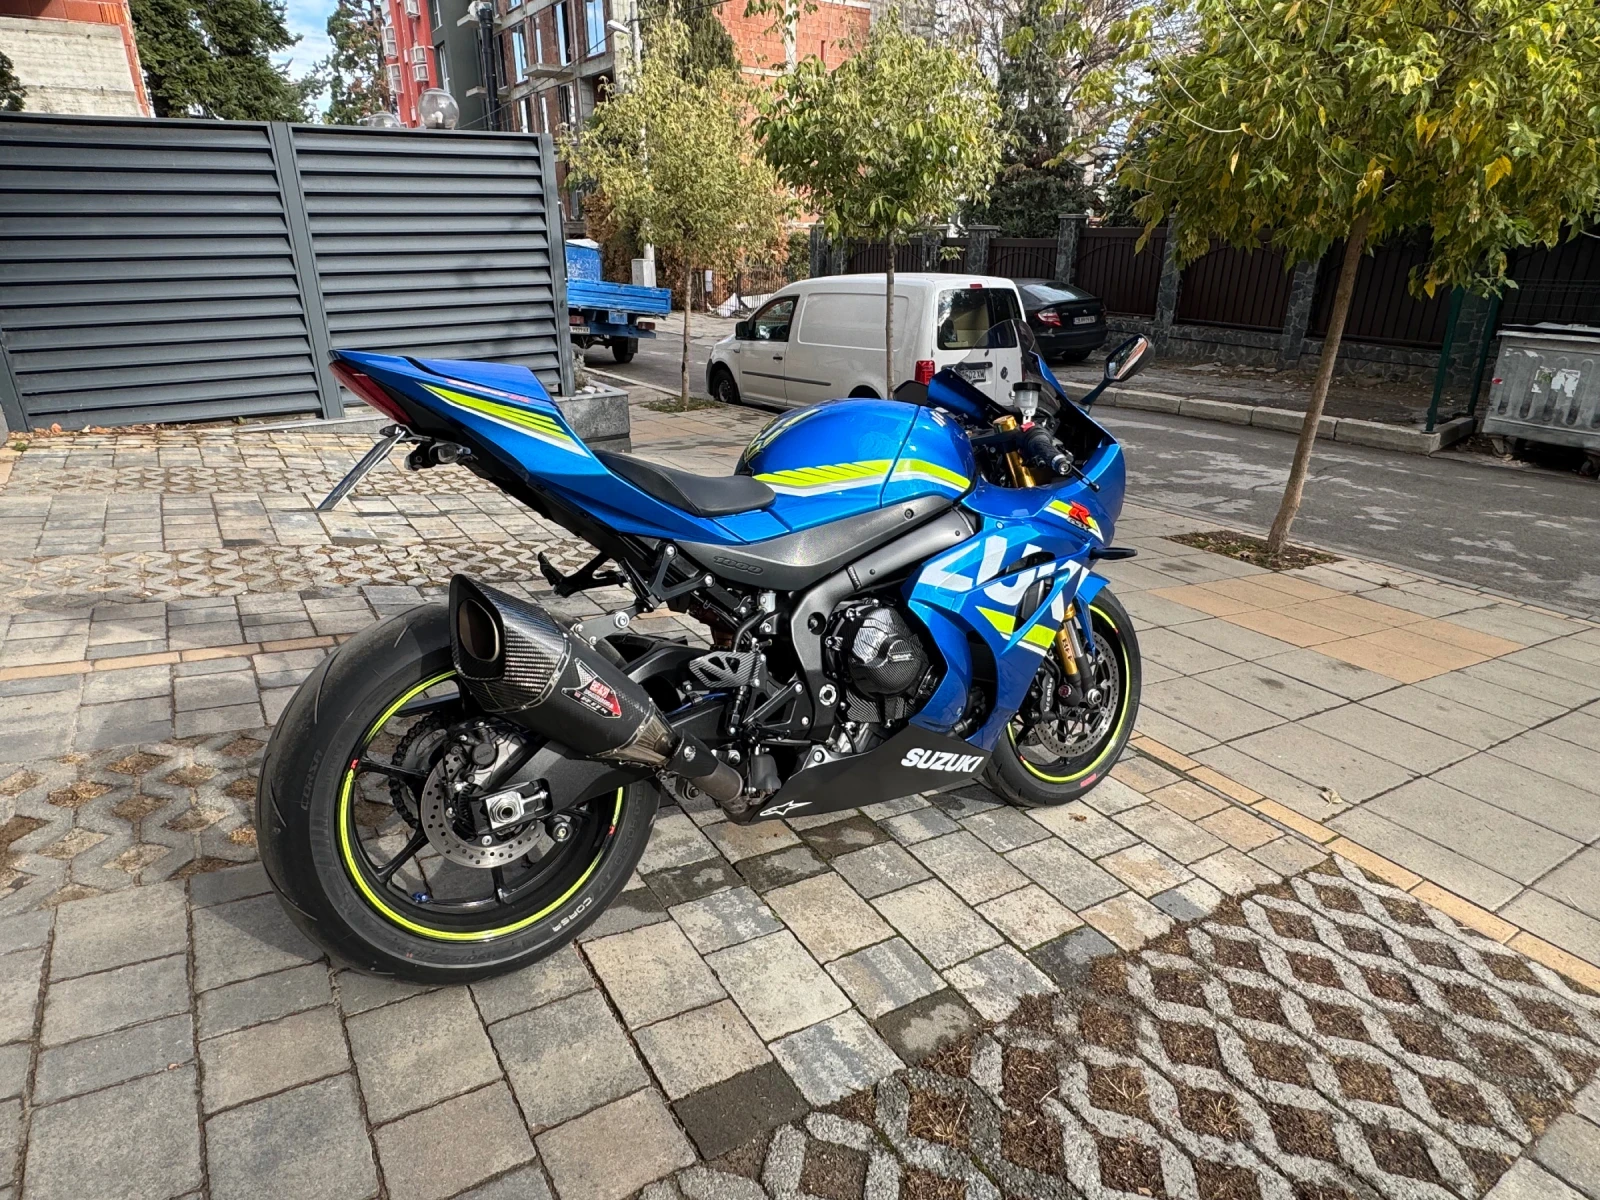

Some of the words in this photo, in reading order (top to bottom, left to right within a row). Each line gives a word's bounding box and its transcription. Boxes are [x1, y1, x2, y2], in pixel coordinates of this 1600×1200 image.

[1043, 677, 1054, 712] brembo
[901, 748, 984, 773] SUZUKI
[300, 749, 323, 811] CORSA
[552, 897, 593, 932] CORSA
